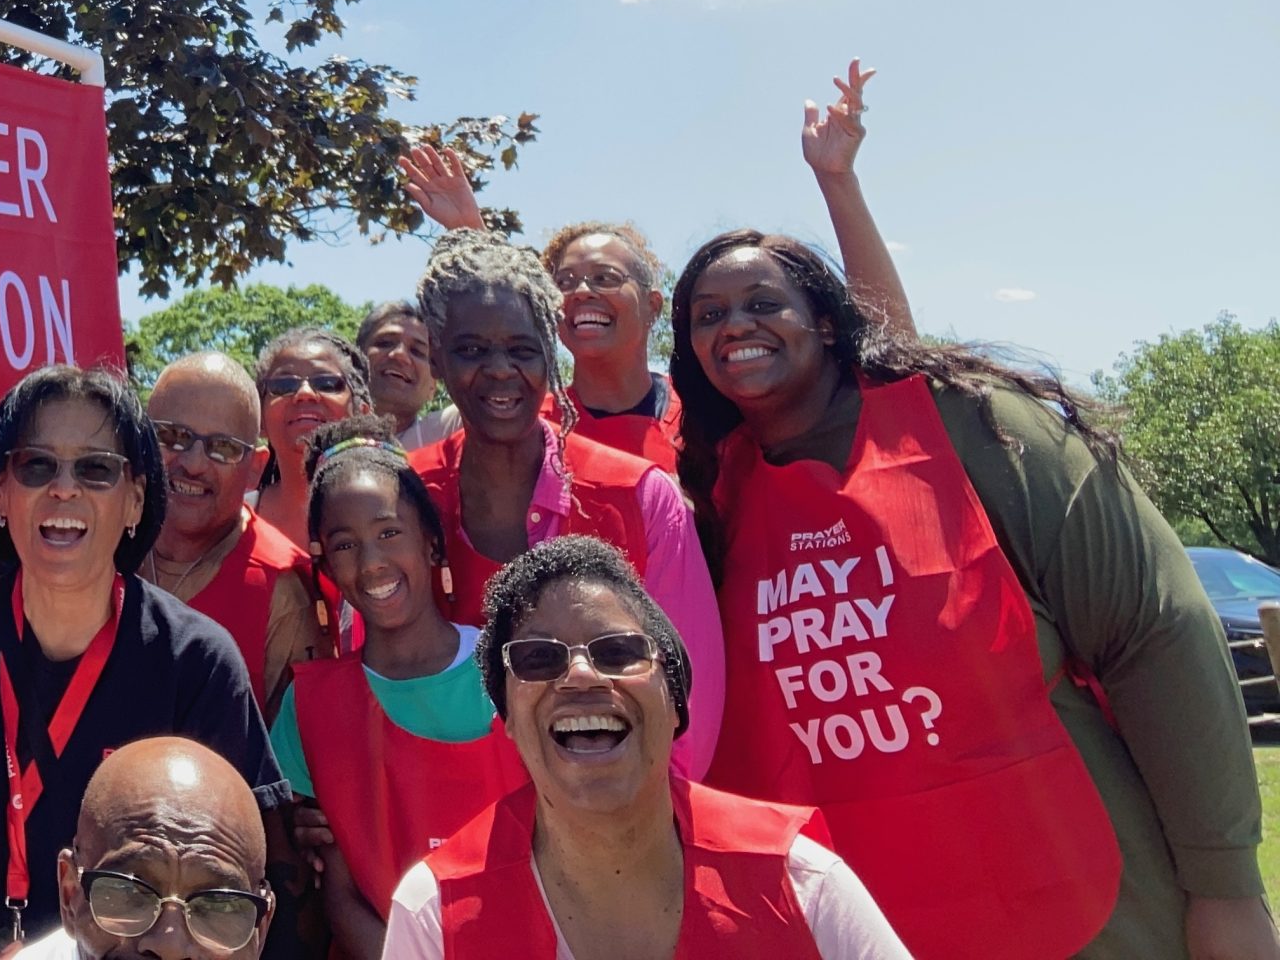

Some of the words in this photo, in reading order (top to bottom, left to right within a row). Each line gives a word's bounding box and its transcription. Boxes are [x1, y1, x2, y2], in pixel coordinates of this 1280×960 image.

[790, 531, 851, 551] STATIONS
[791, 518, 846, 541] PRAYER
[757, 557, 861, 615] MAY
[875, 545, 894, 587] I
[758, 594, 896, 662] PRAY
[775, 651, 894, 709] FOR
[789, 686, 943, 765] YOU?
